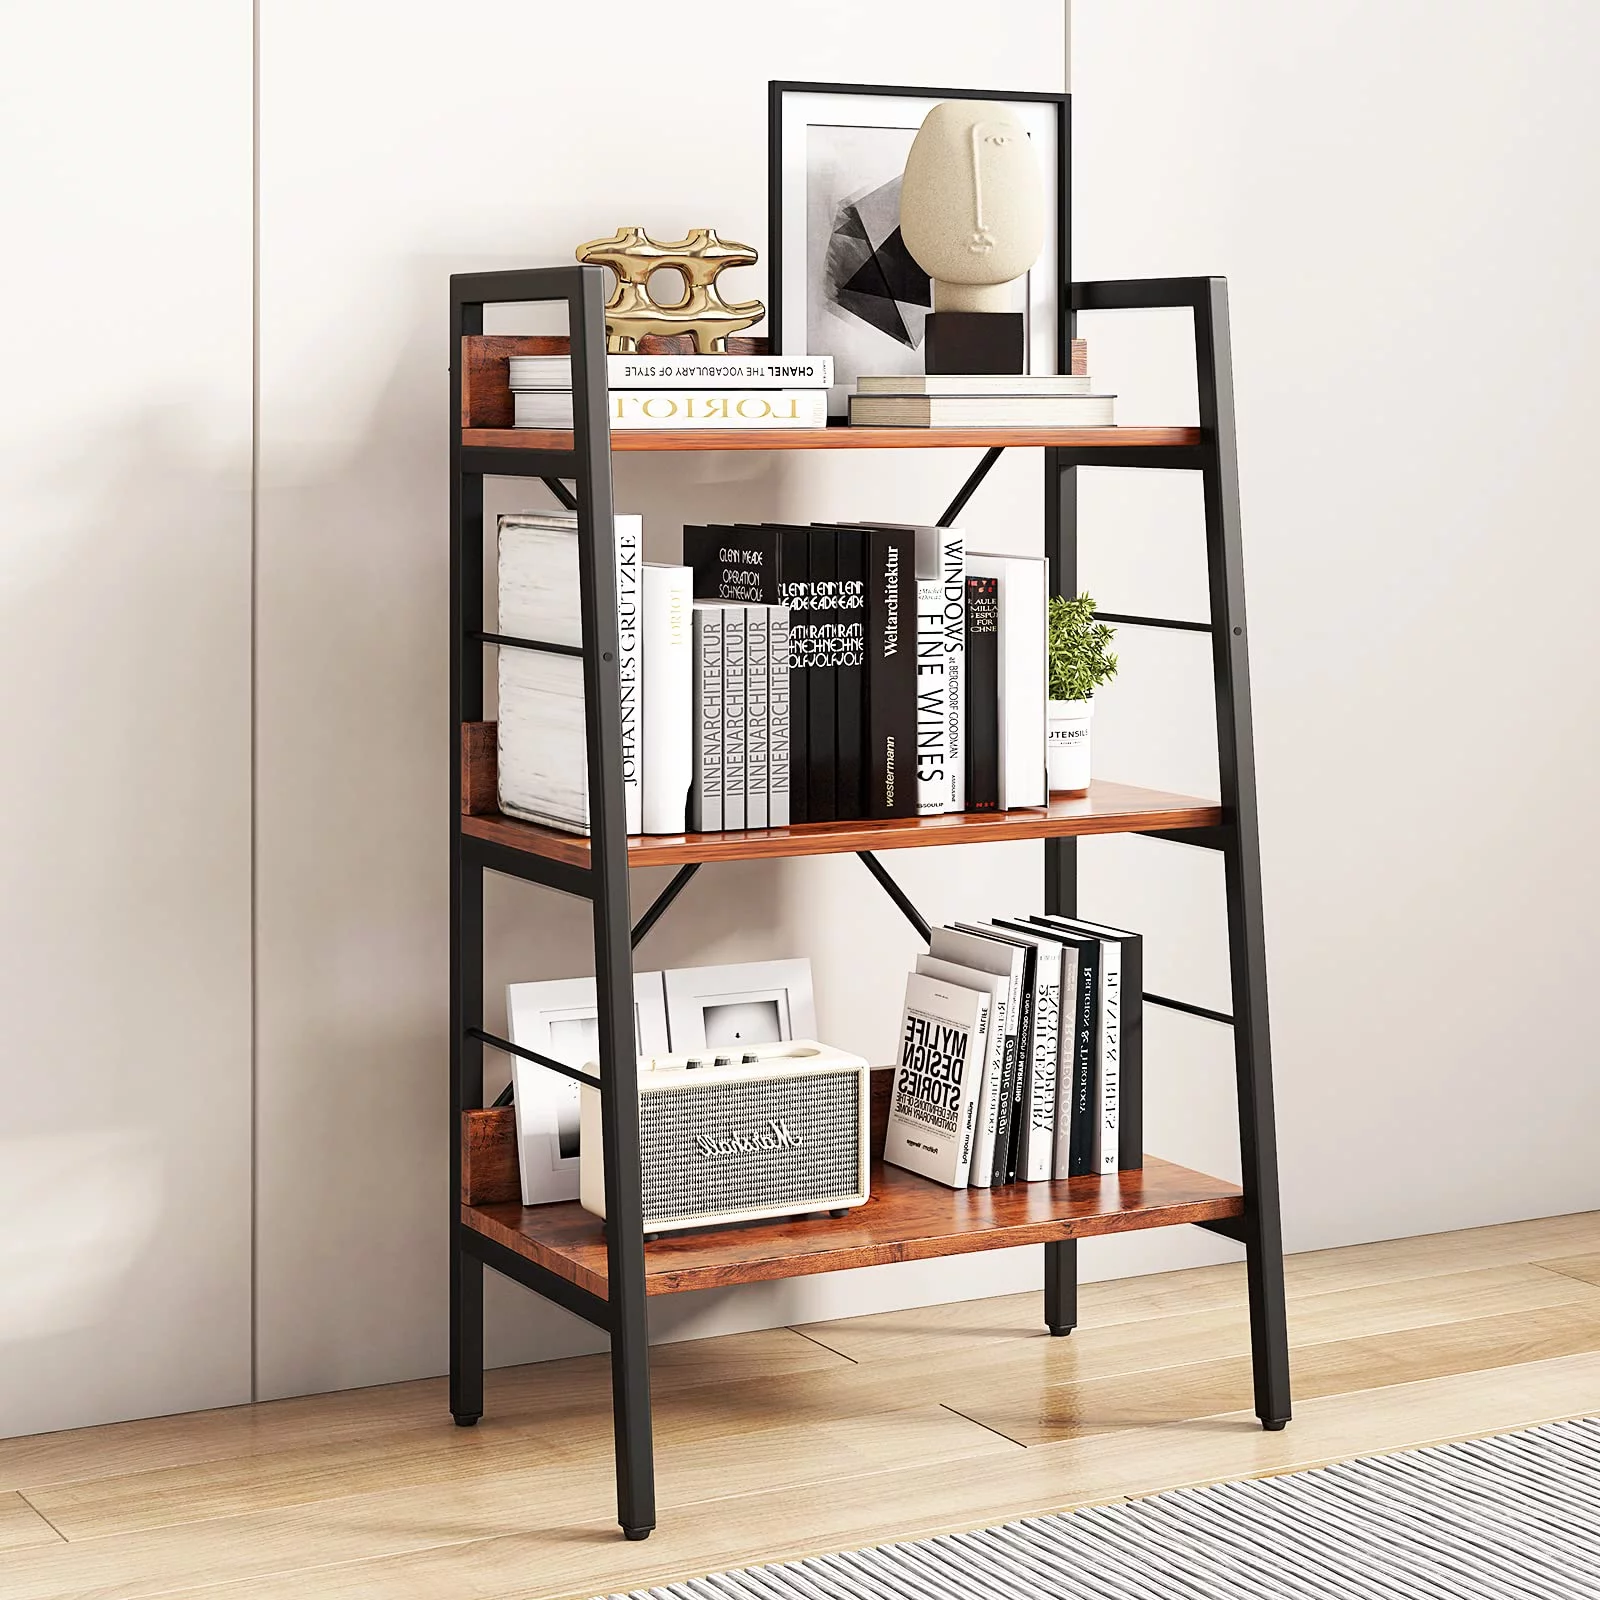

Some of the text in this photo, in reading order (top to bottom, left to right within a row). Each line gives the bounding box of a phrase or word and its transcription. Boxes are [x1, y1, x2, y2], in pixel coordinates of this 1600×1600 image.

[625, 366, 814, 376] CHANEL THE VOCABULARY OF STYLE
[719, 548, 763, 566] GLENN MEADE
[719, 584, 763, 602] SCHNEEWOLF
[722, 569, 760, 586] OPERATION
[884, 546, 898, 658] Weltarchitektur
[944, 539, 964, 653] WINDOWS
[618, 535, 638, 786] JOHANNES GRÜTZKE
[704, 624, 720, 798] INNENARCHITEKTUR
[726, 622, 744, 796] INNENARCHITEKTUR
[750, 622, 766, 795] INNENARCHITEKTUR
[772, 621, 788, 793] INNENARCHITEKTUR
[916, 615, 944, 782] FINE WINES
[948, 666, 958, 711] BERGDORF
[885, 736, 895, 807] westermann
[948, 712, 958, 759] GOODMAN
